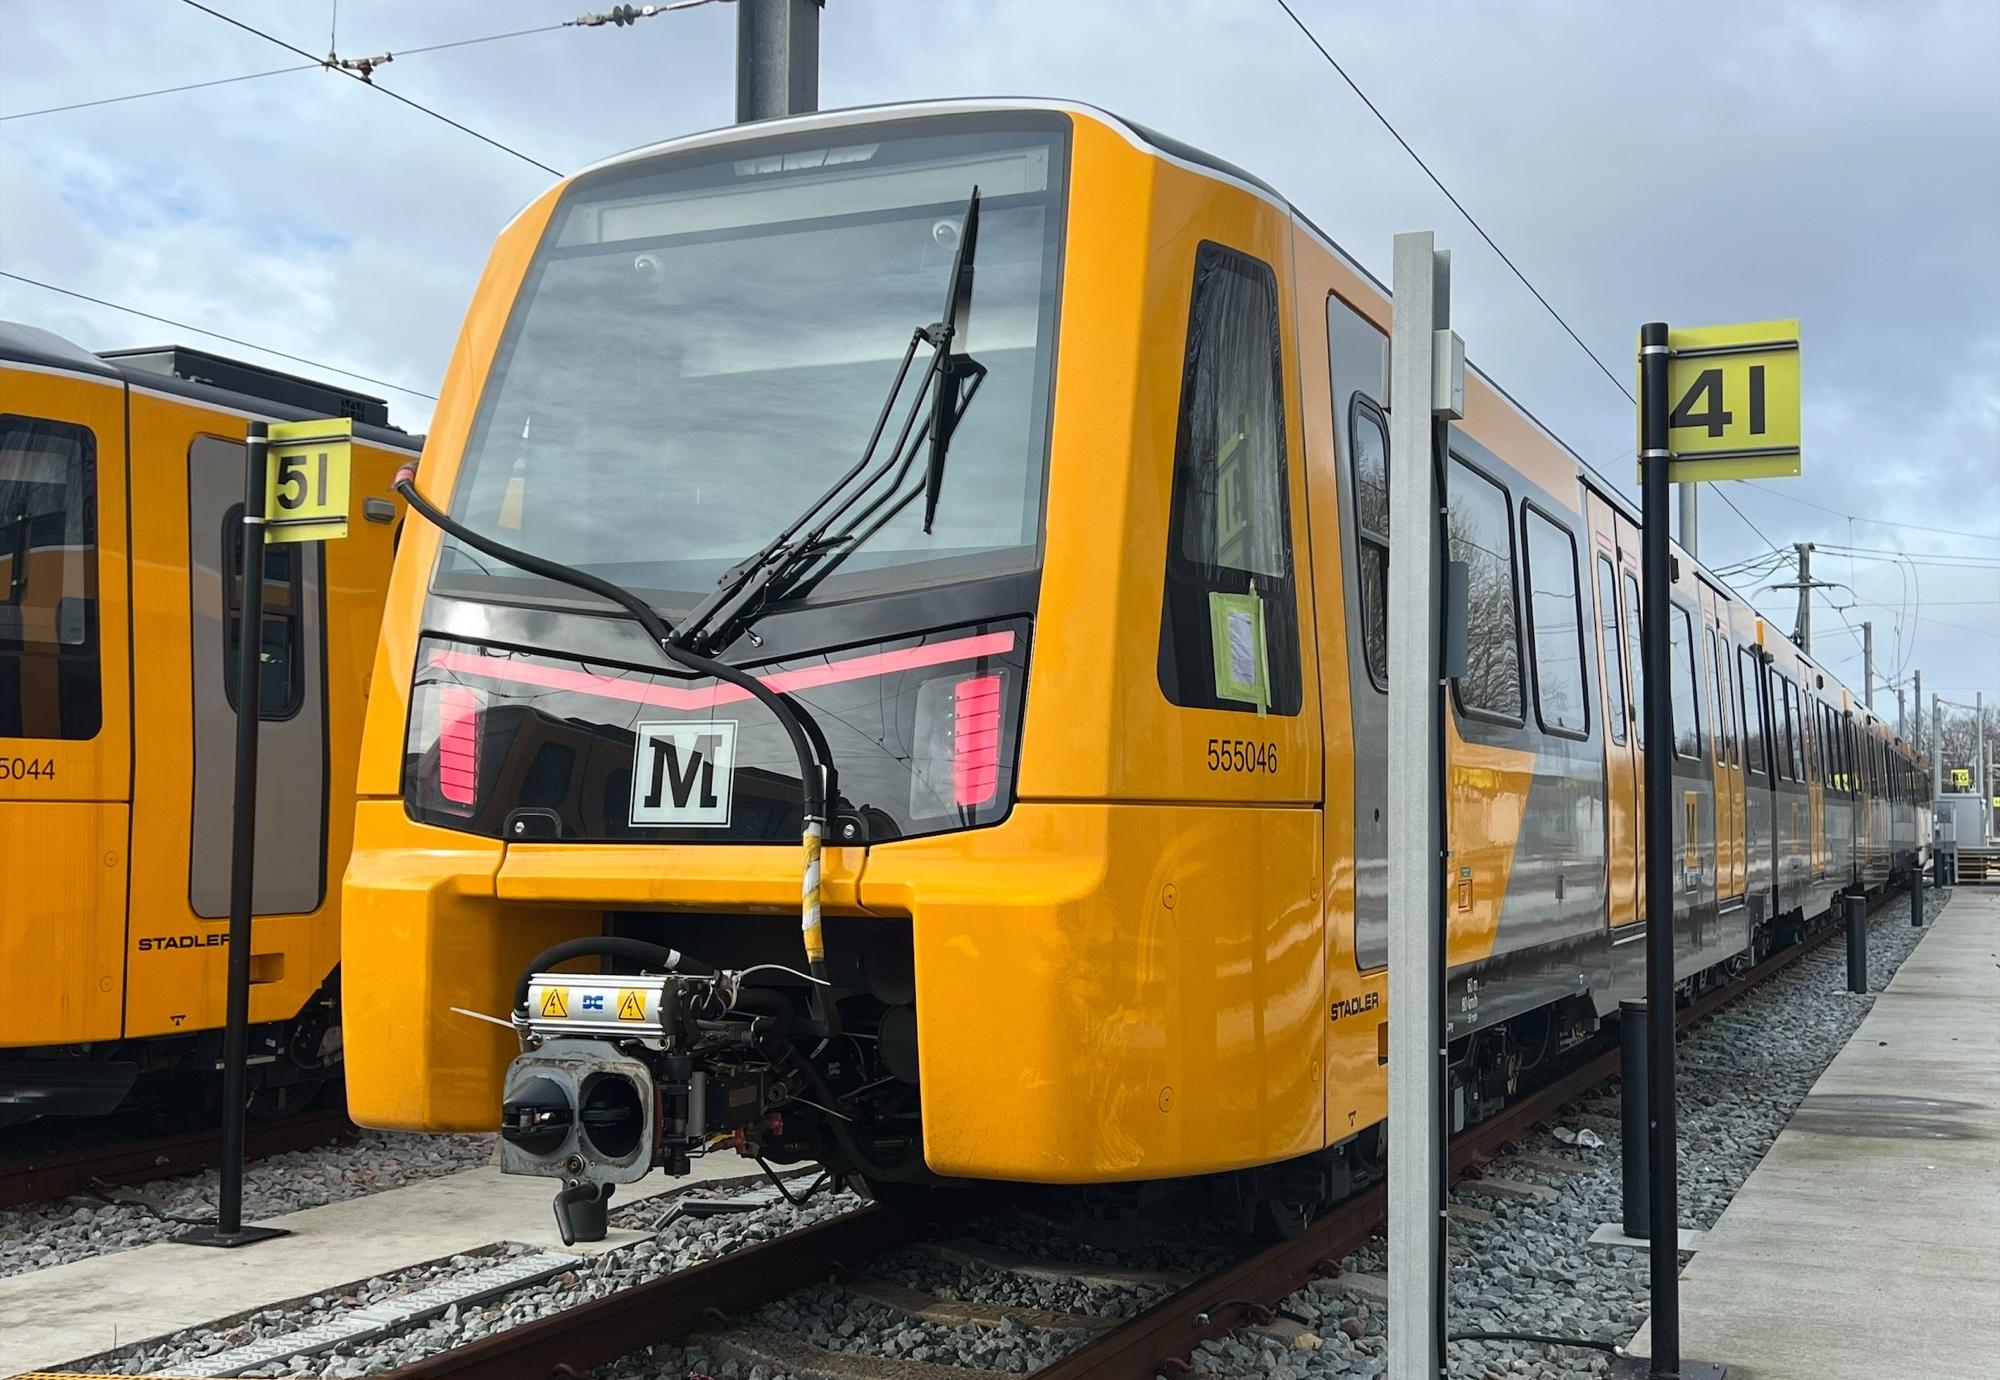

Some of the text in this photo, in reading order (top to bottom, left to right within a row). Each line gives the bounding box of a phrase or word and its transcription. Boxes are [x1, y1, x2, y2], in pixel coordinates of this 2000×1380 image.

[1669, 365, 1766, 438] 41
[277, 453, 327, 510] 51
[0, 757, 56, 780] 5044
[643, 734, 723, 808] M
[1208, 738, 1277, 774] 555046
[1331, 991, 1379, 1022] STADLER
